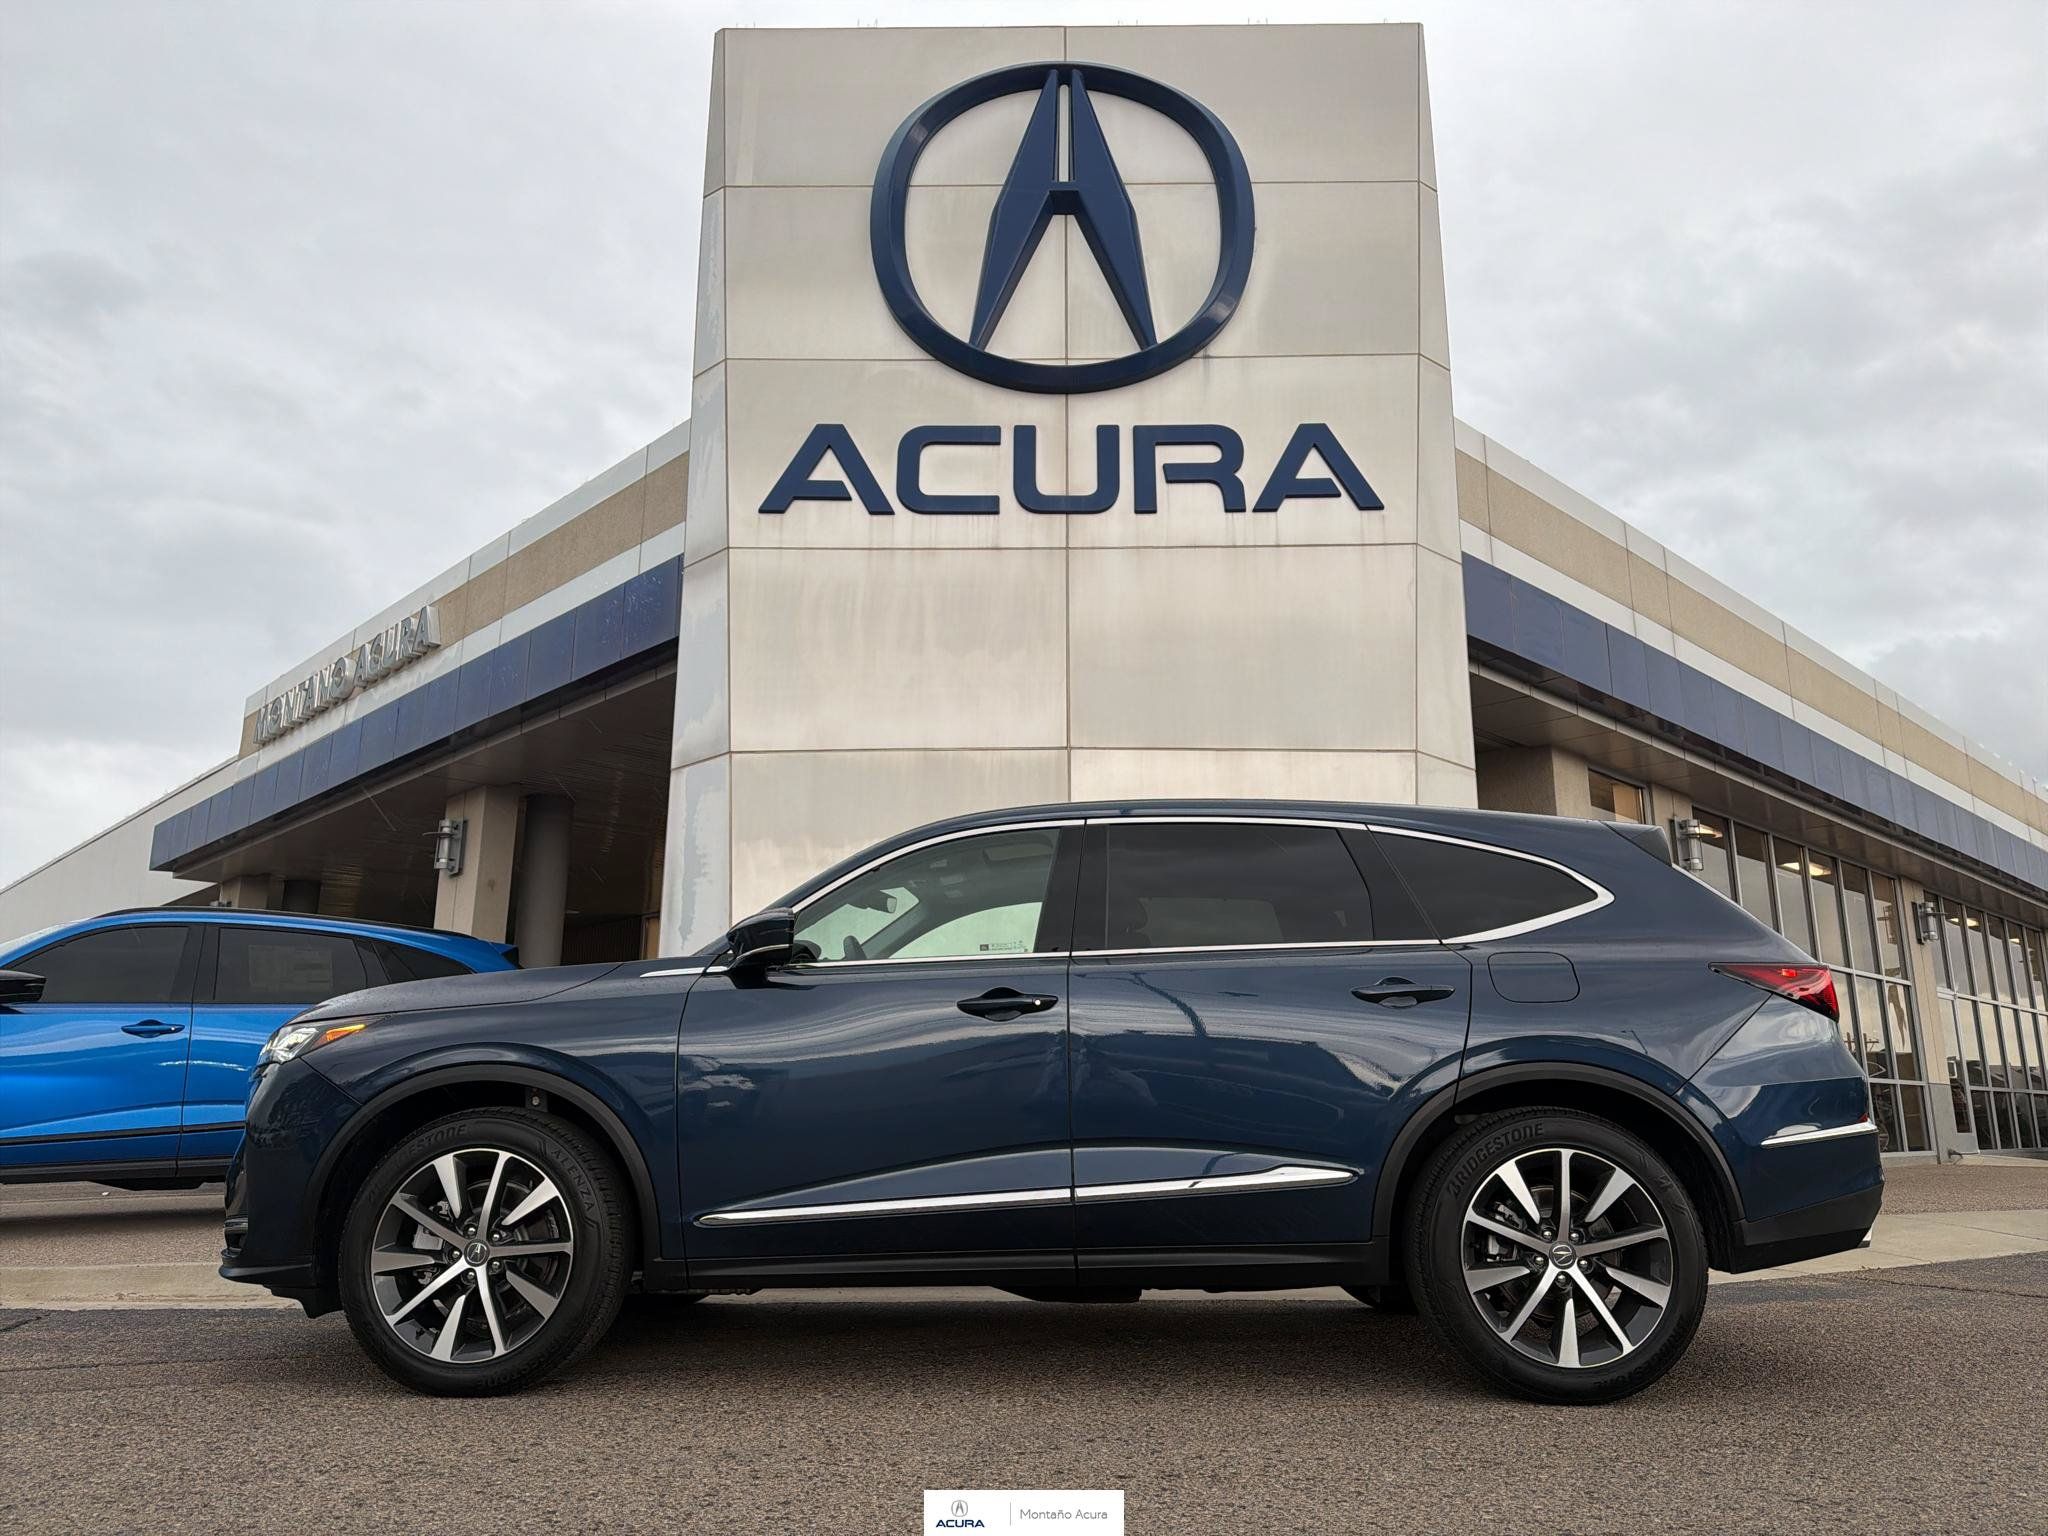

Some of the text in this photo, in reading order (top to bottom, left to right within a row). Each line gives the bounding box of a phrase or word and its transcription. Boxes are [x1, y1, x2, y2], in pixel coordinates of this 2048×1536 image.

[758, 422, 1385, 516] ACURA
[354, 605, 441, 689] ACURA
[551, 1149, 595, 1212] ALENZA
[1447, 1122, 1544, 1196] BRIDGESTONE
